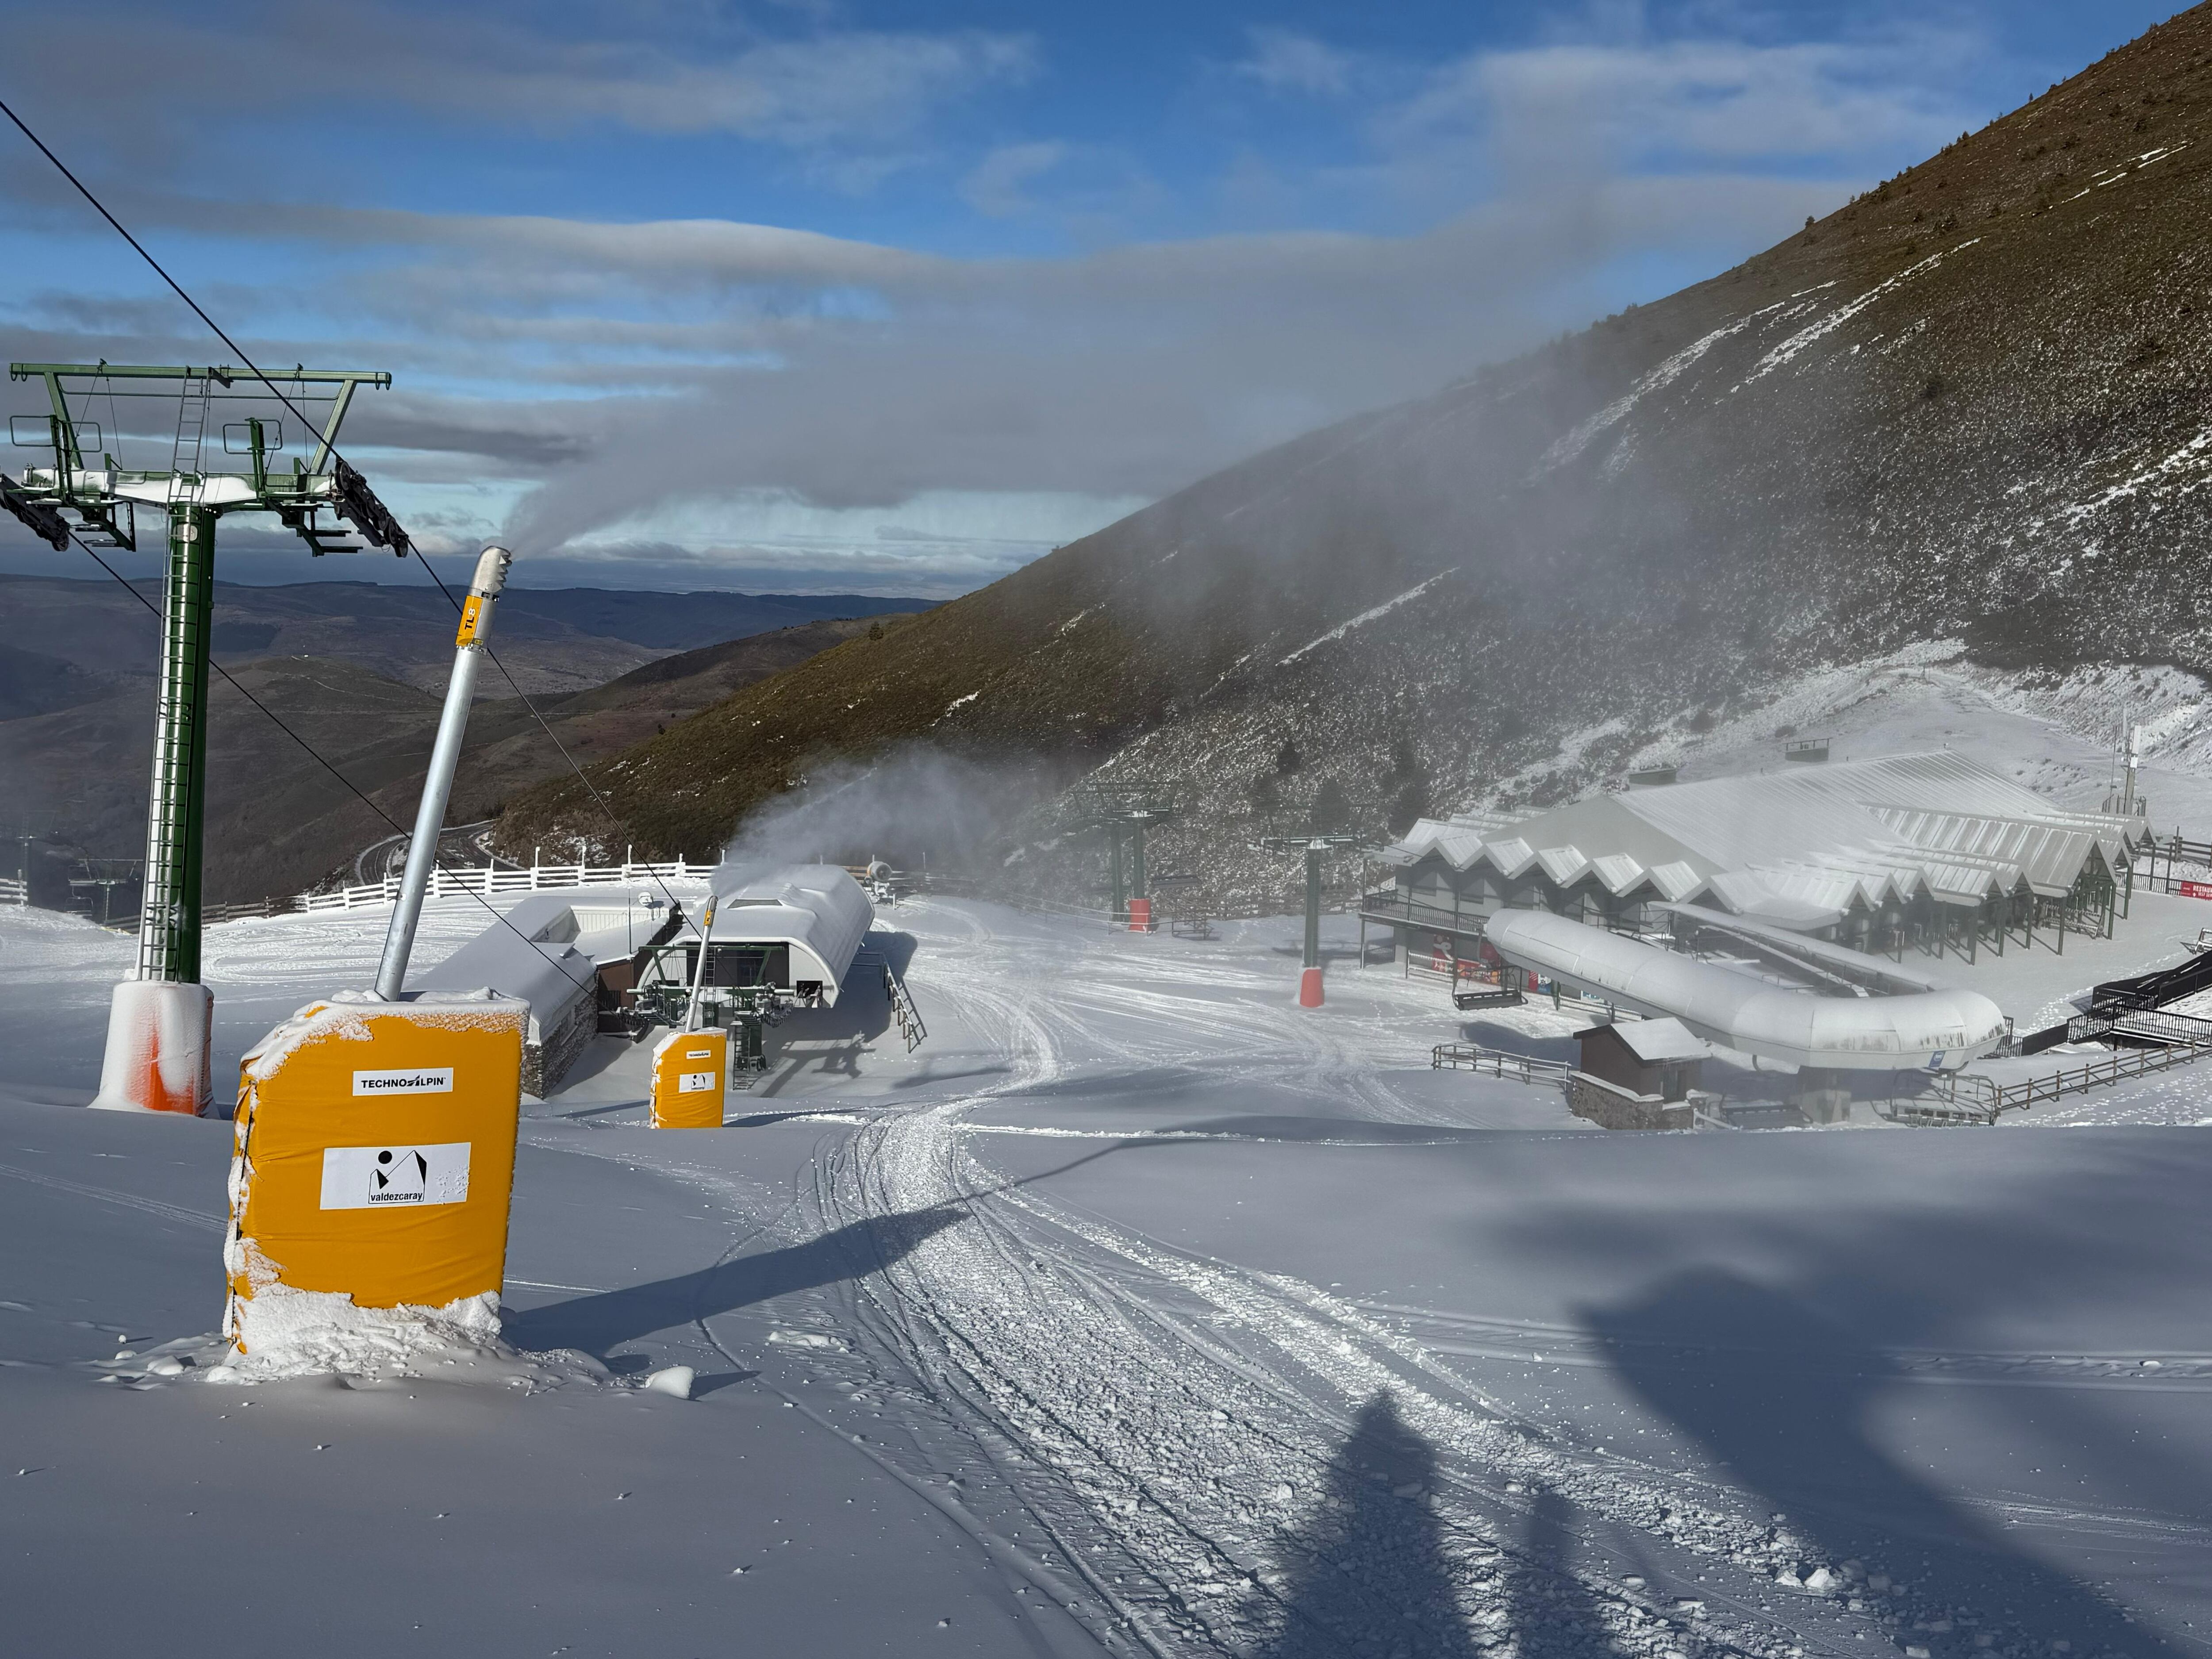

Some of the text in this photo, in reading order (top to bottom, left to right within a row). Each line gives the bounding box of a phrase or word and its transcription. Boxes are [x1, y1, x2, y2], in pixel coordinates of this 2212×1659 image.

[465, 608, 476, 630] TL8
[361, 1075, 444, 1088] TECHNOALPIN
[371, 1193, 422, 1202] valdezcaray
